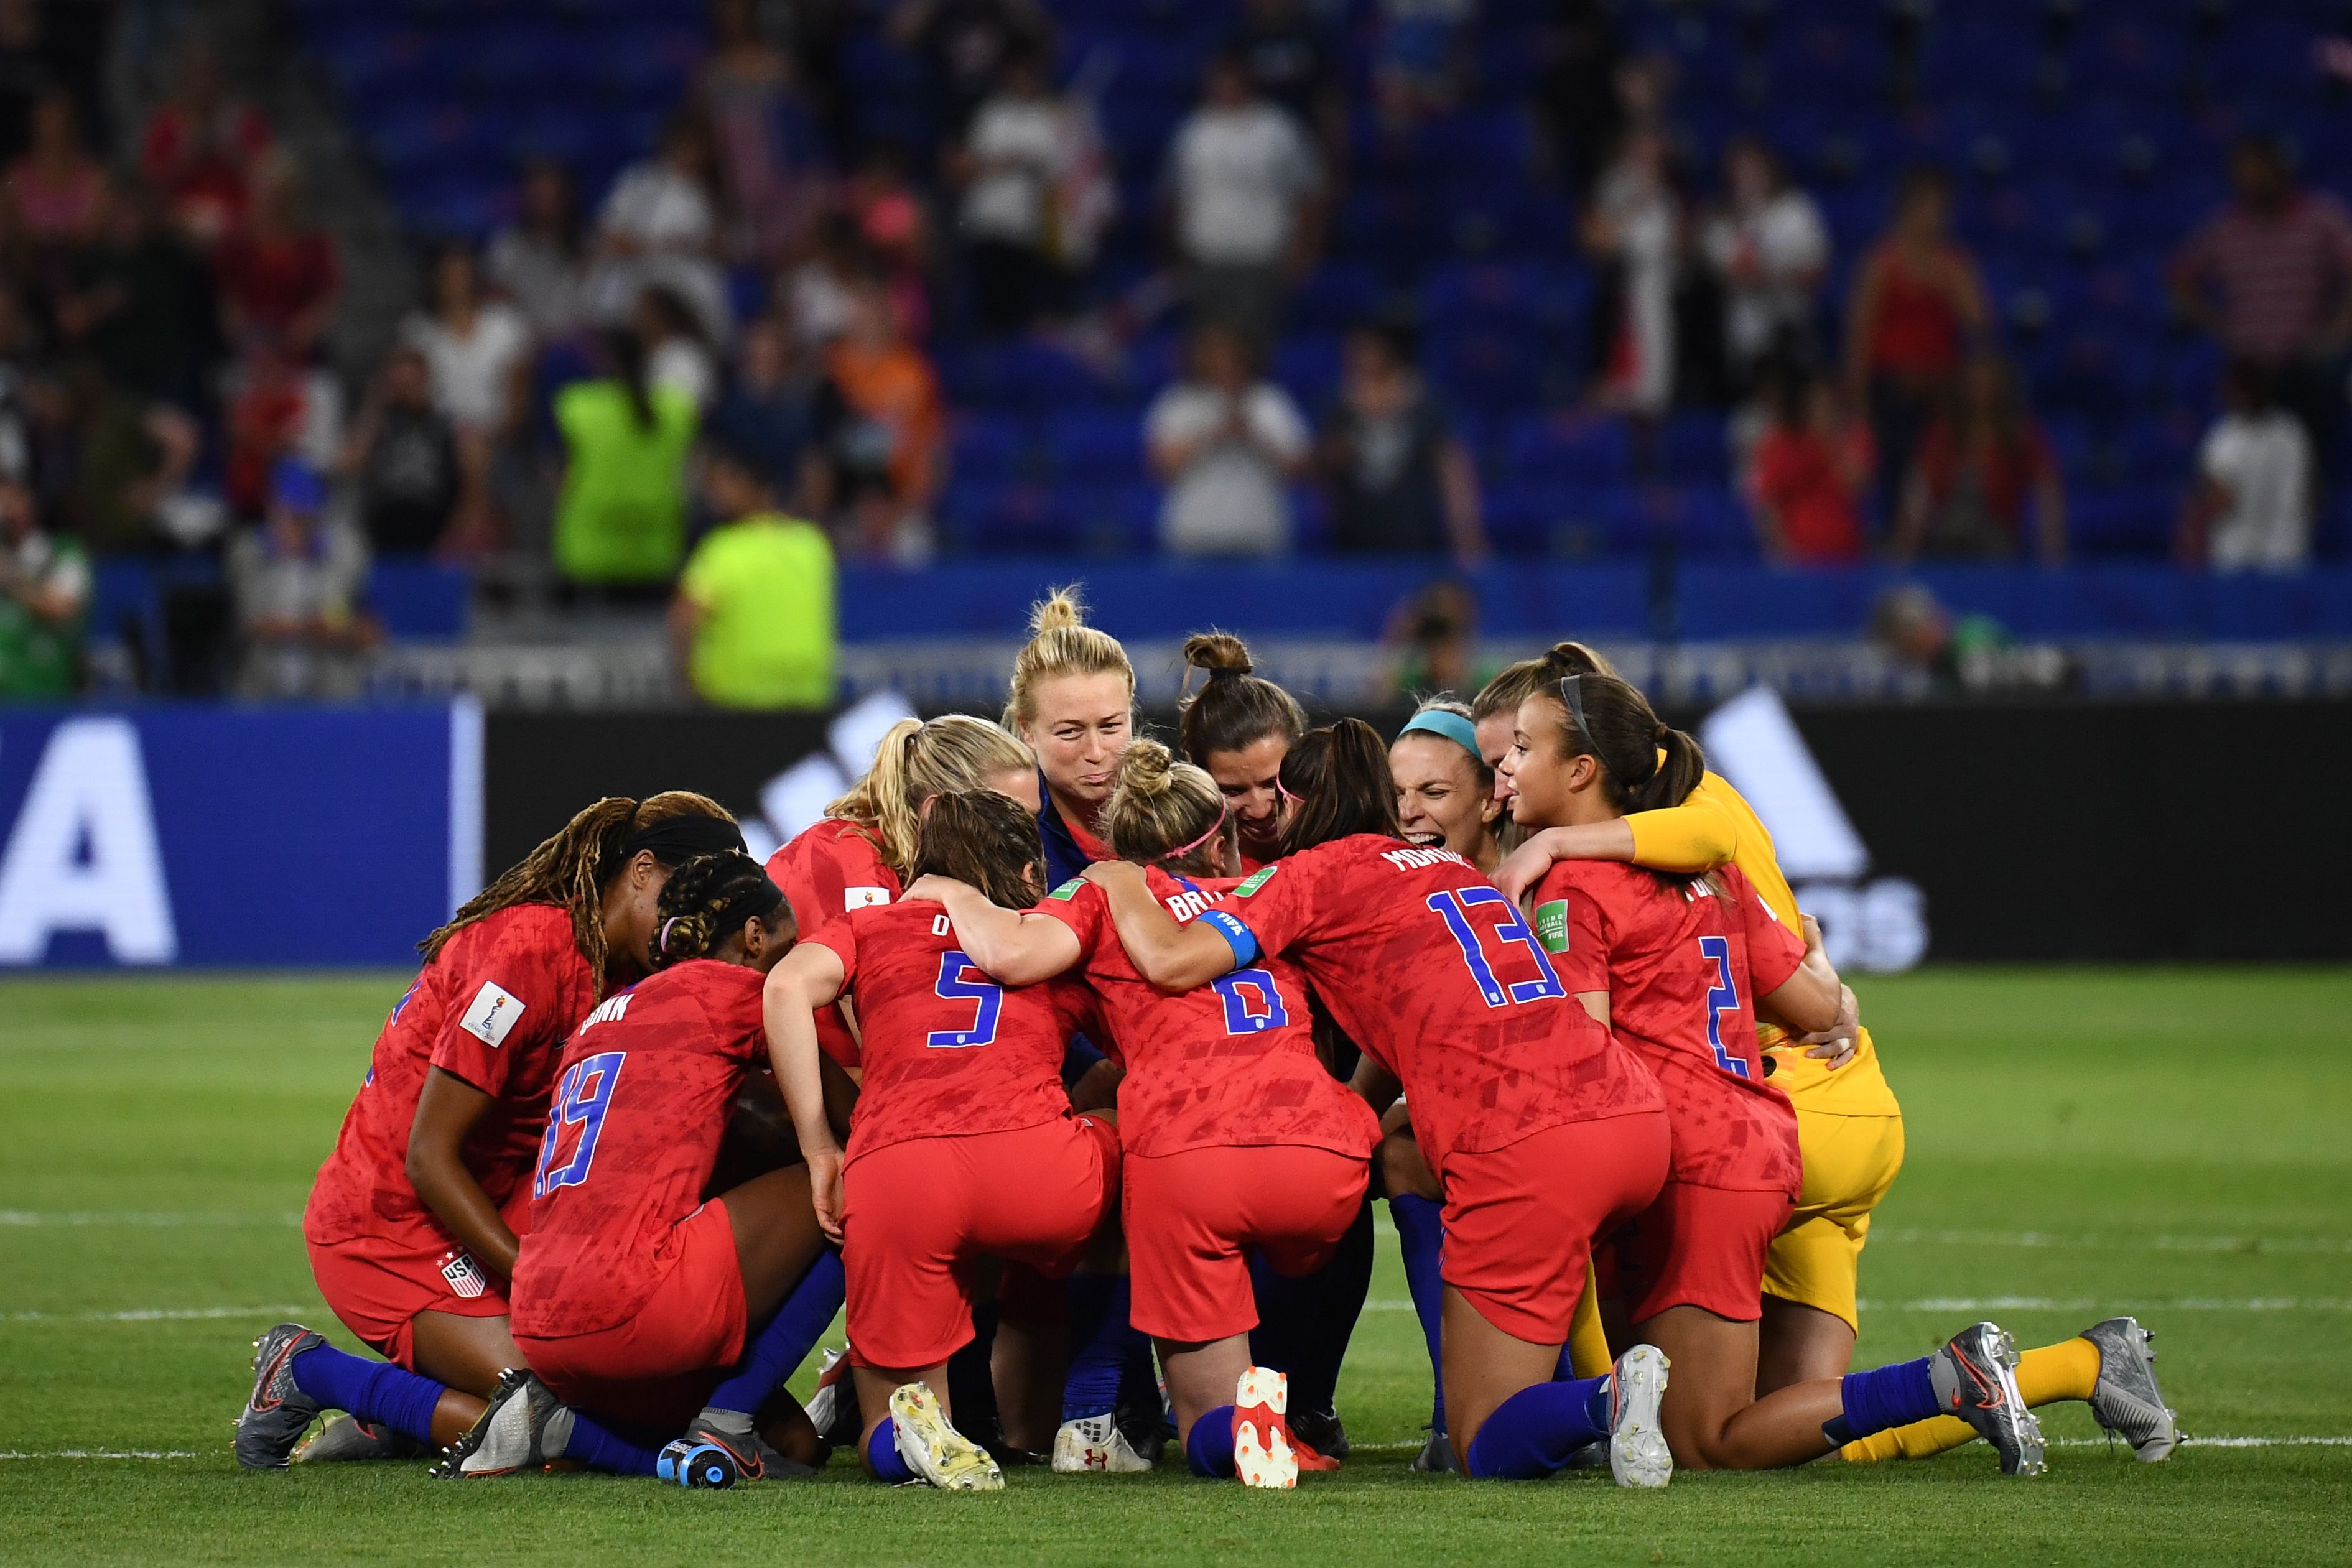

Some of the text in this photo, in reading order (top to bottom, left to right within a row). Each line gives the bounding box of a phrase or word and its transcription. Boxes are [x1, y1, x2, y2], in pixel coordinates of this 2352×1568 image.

[1217, 912, 1243, 937] FIFA
[1425, 885, 1568, 1008] 13
[1548, 930, 1563, 940] FIFA
[926, 951, 1003, 1048] 5
[1698, 935, 1751, 1080] 2
[532, 1051, 626, 1200] 19
[445, 1256, 473, 1279] USA
